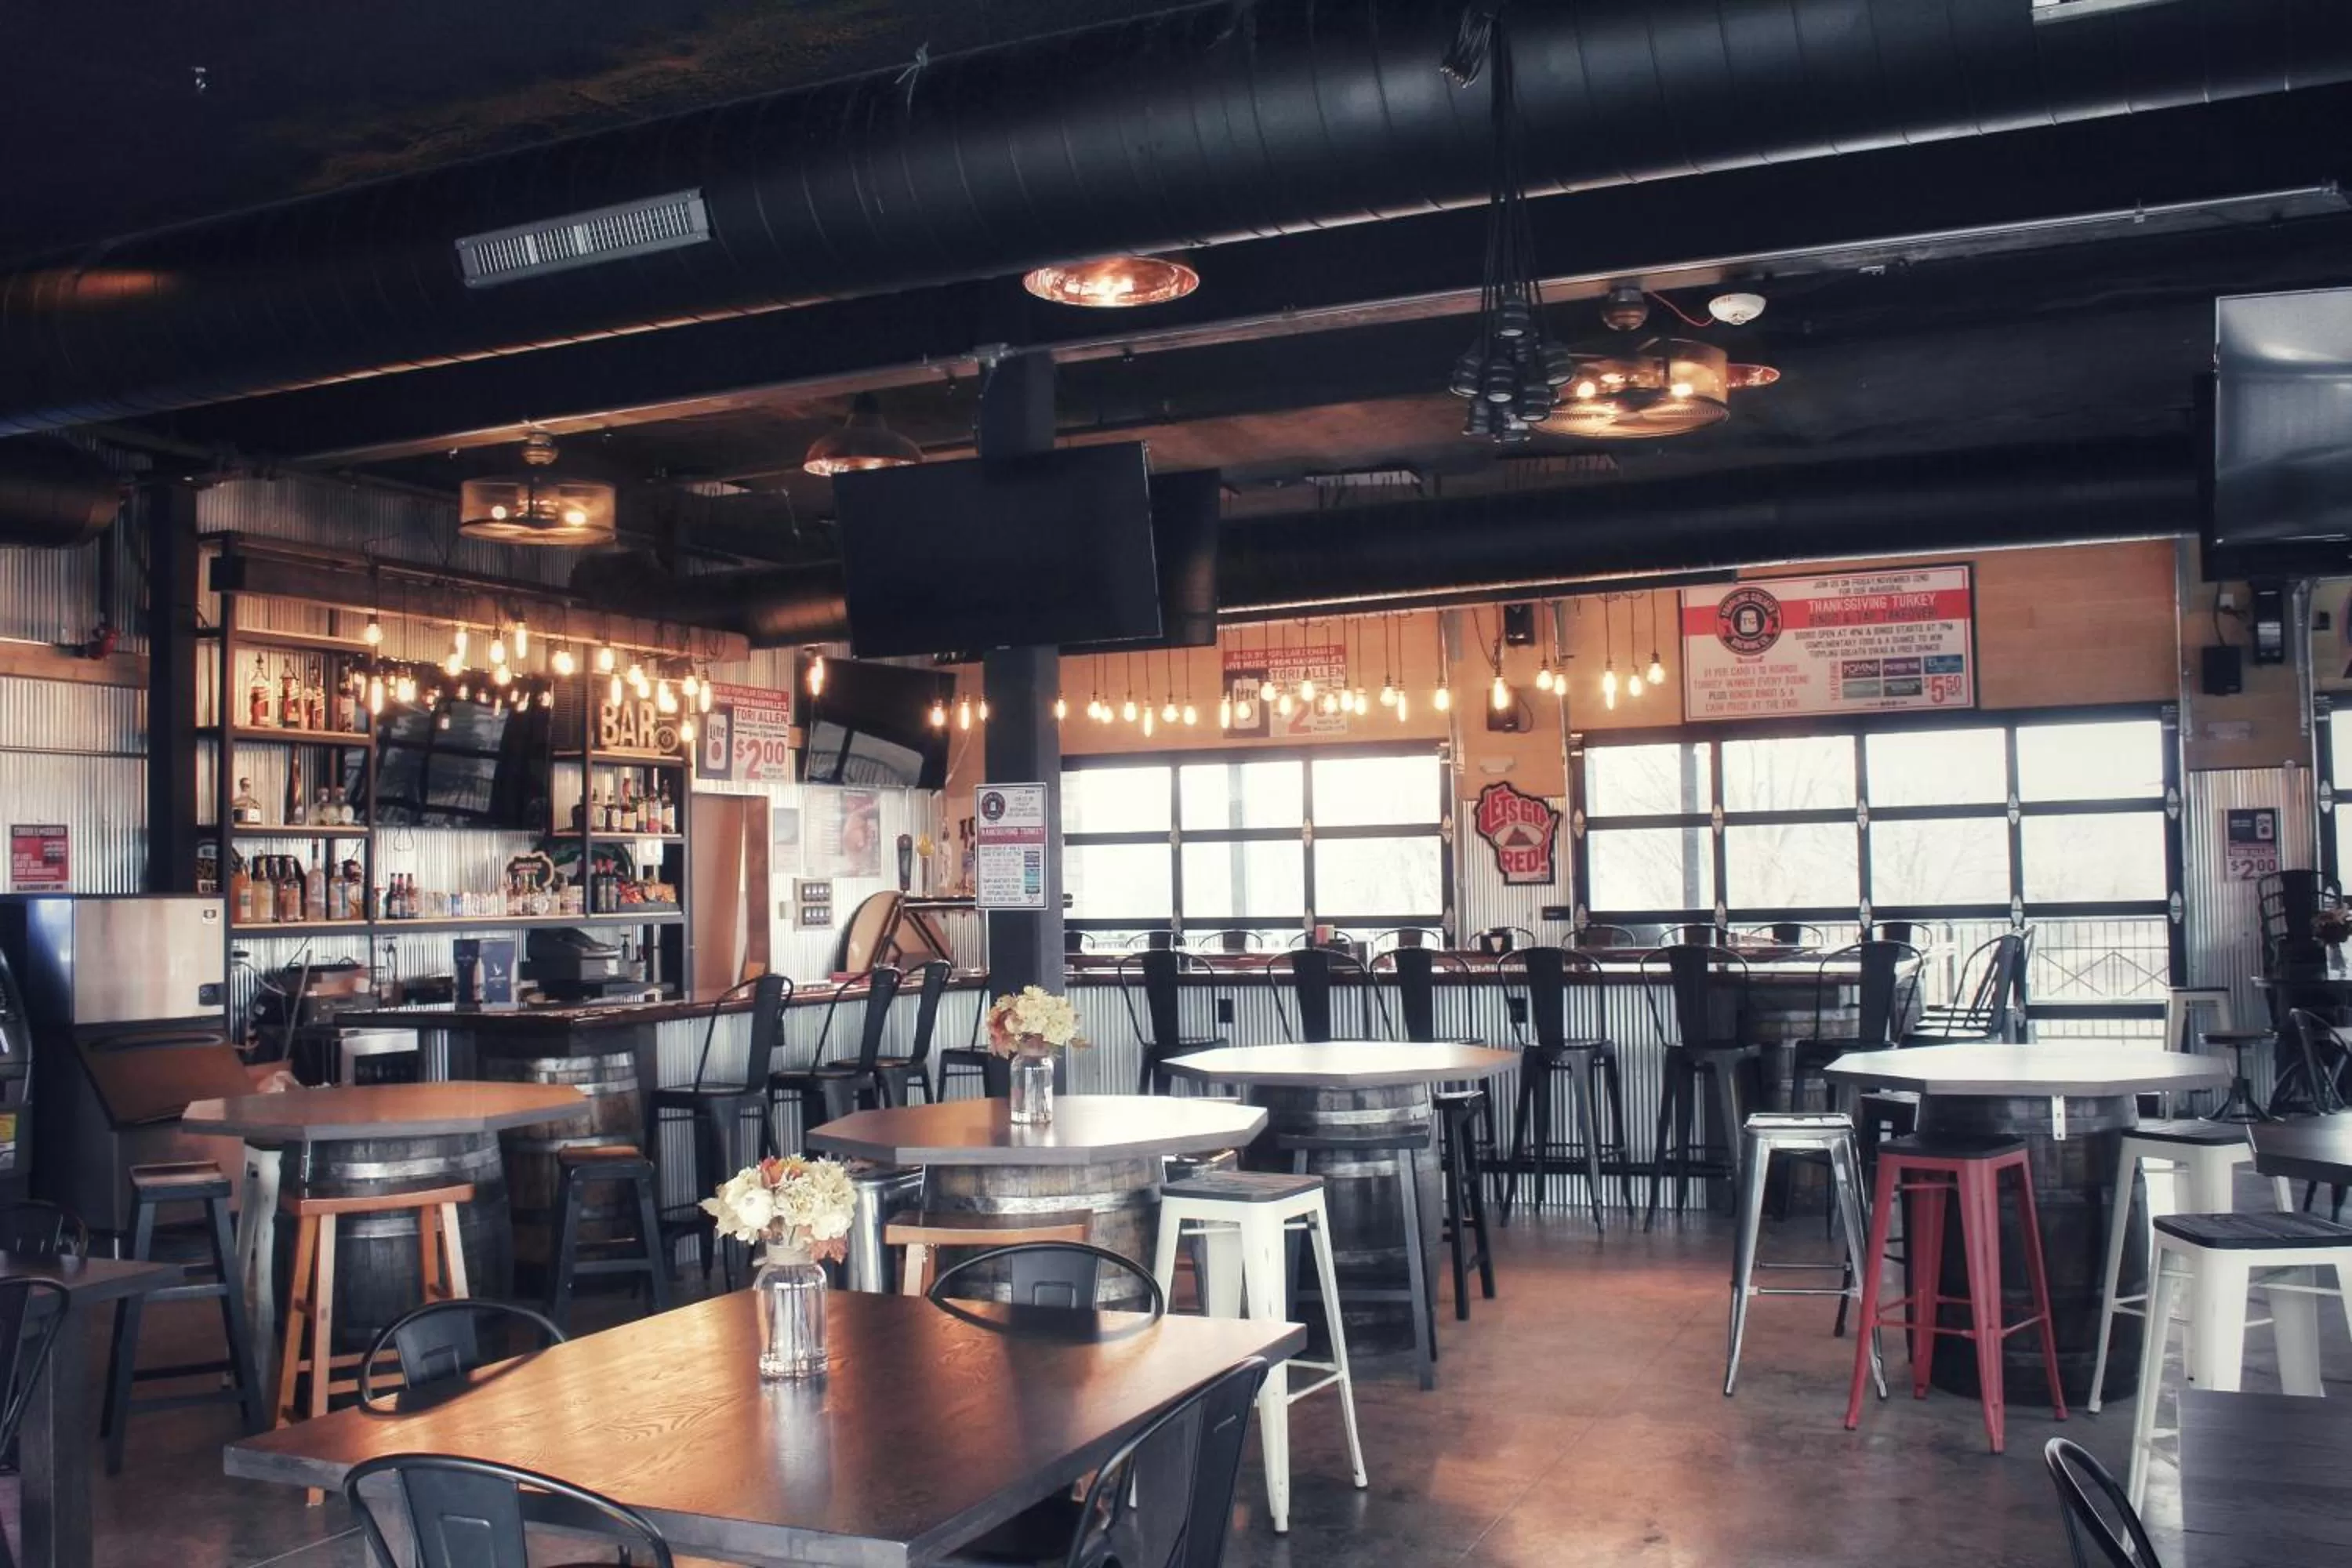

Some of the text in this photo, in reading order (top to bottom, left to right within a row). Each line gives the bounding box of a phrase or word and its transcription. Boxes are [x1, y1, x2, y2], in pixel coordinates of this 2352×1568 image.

[1809, 593, 1936, 612] THANKSGIVING TURKEY
[1818, 630, 1835, 639] OPEN
[1837, 629, 1846, 637] AT
[1866, 627, 1873, 636] &
[1243, 660, 1267, 669] MUSIC
[1272, 666, 1344, 680] TORI ALLEN
[601, 699, 656, 747] BAR
[735, 708, 788, 724] TORI ALLEN
[710, 724, 726, 741] Lite
[1520, 800, 1547, 828] GO
[1501, 847, 1548, 872] RED!
